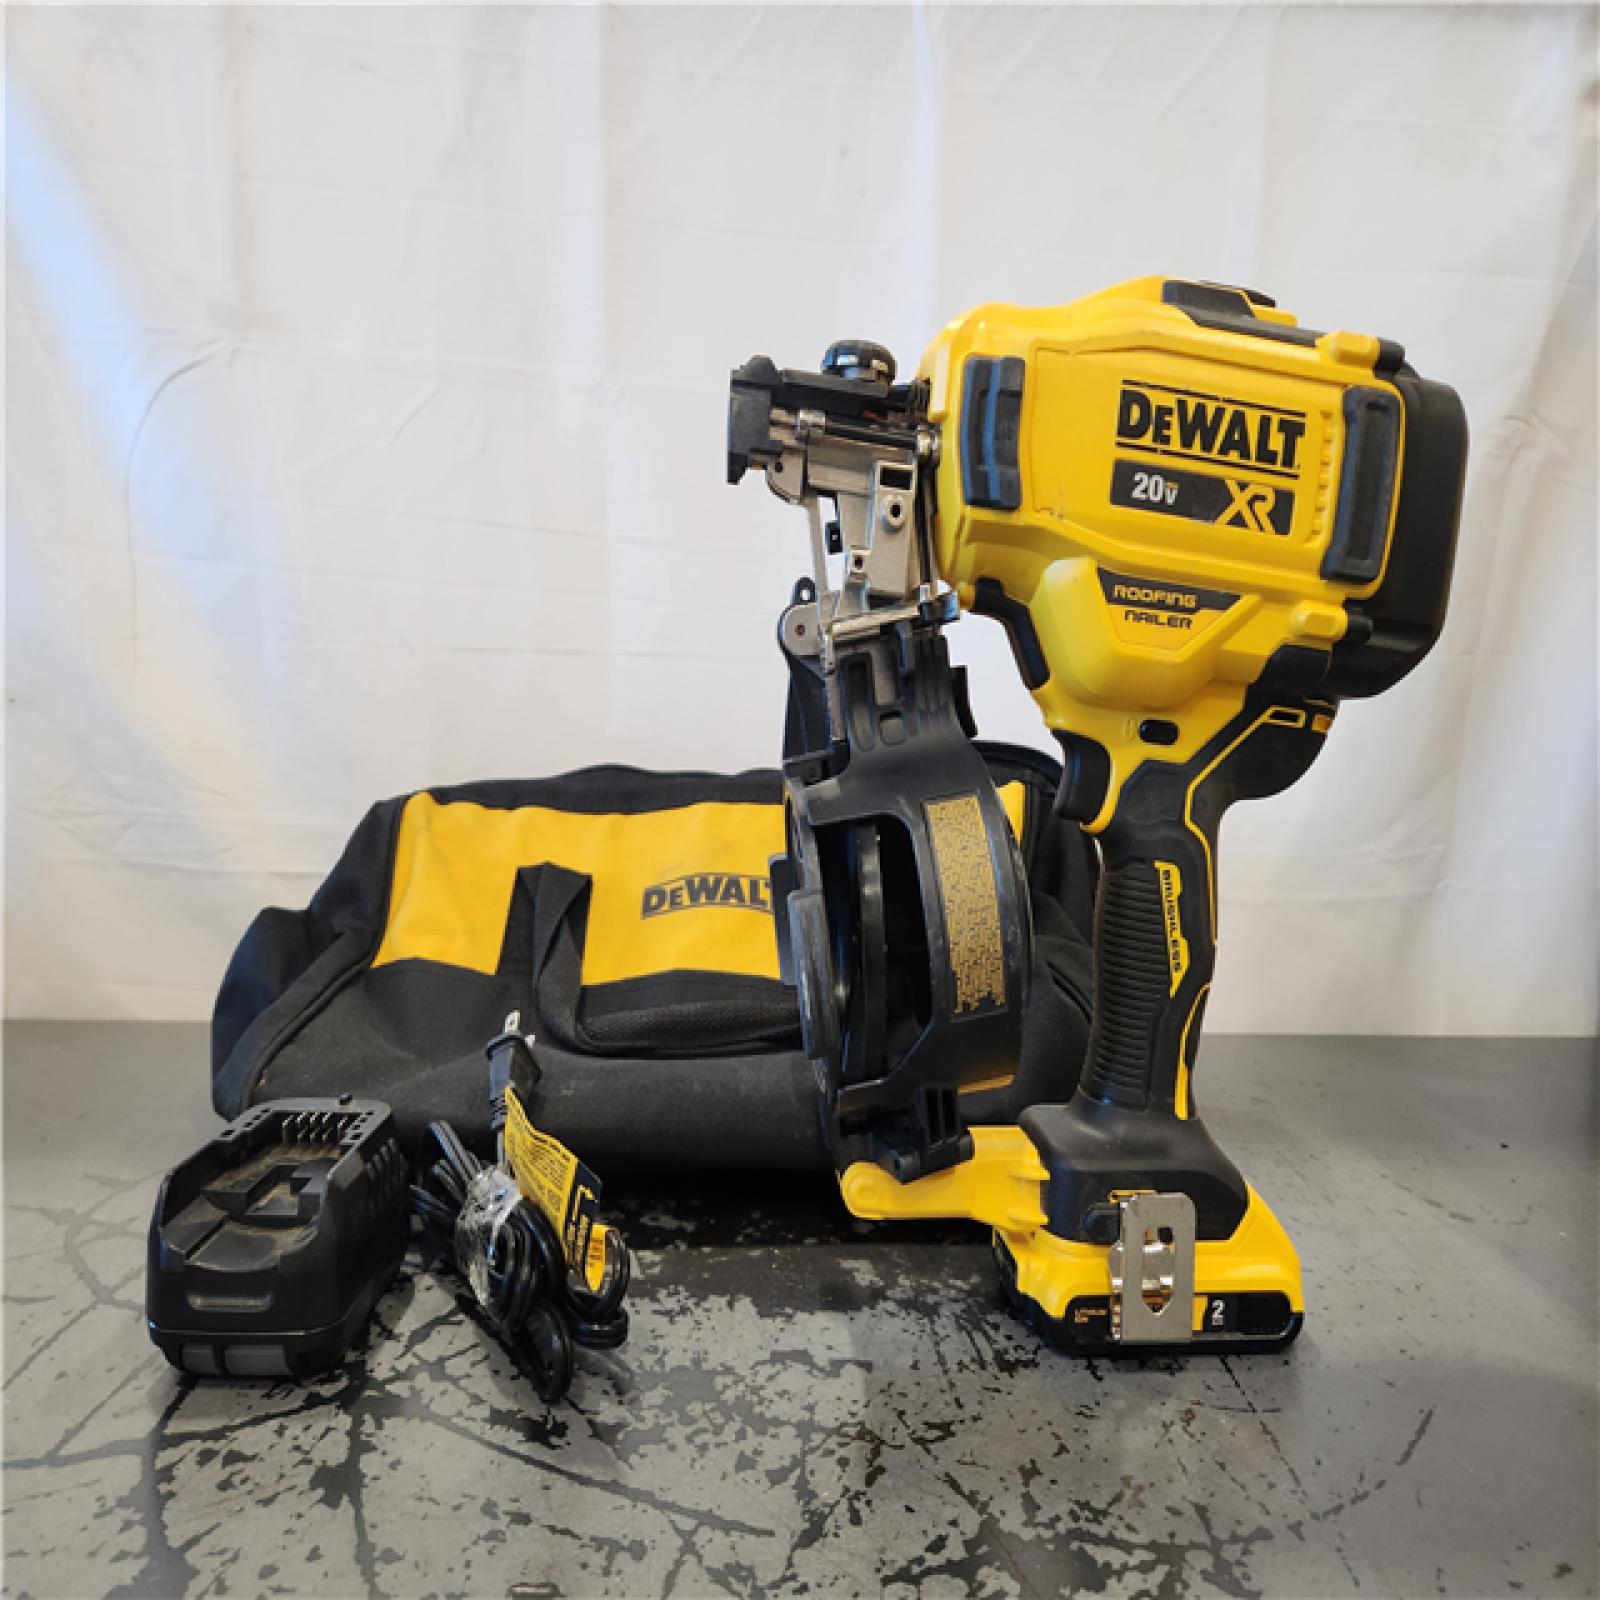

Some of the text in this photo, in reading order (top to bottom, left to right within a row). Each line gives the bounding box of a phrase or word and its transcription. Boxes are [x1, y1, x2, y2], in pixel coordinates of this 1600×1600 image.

[1215, 480, 1275, 535] XR
[1113, 585, 1196, 608] ROOFING
[1124, 610, 1193, 629] NAILER
